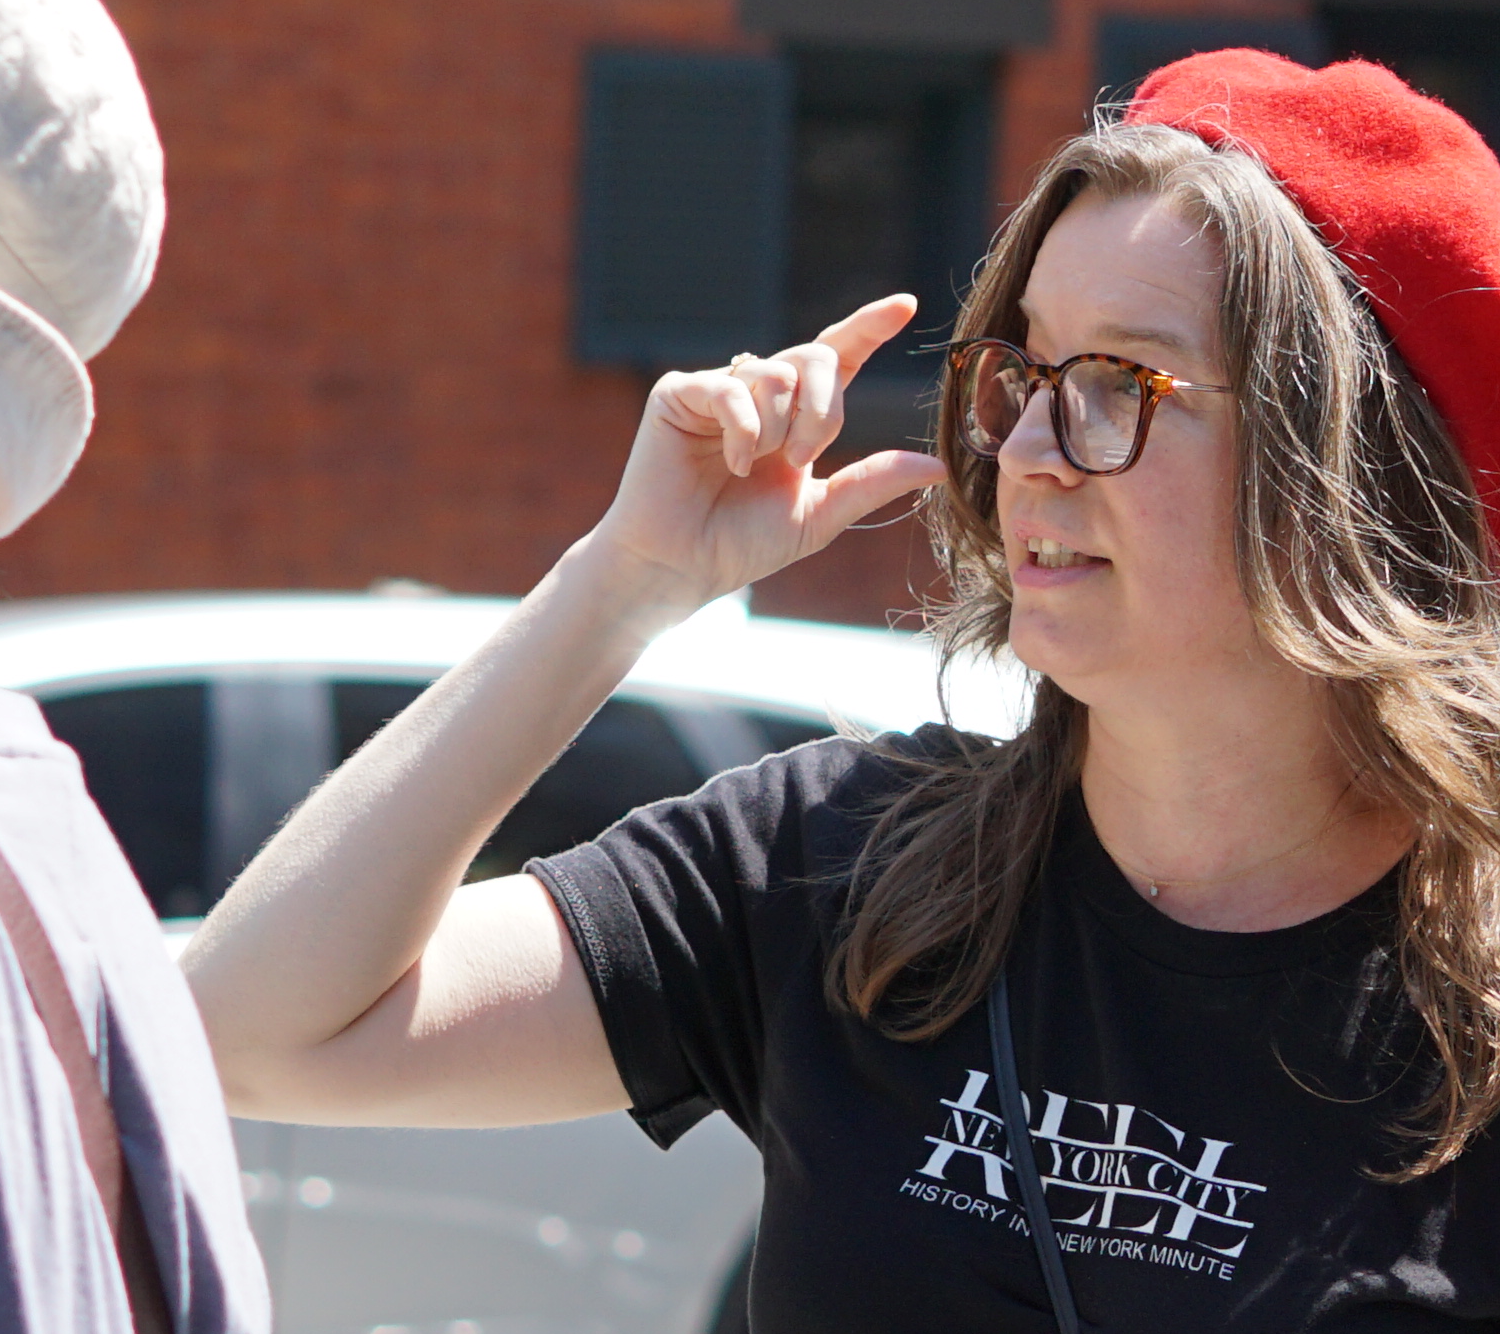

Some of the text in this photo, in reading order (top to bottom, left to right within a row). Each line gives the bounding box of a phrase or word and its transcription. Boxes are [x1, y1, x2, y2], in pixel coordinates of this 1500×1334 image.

[942, 1109, 1250, 1218] NE YORK CITY
[900, 1178, 1235, 1281] HISTORY IN NEW YORK MINUTE
